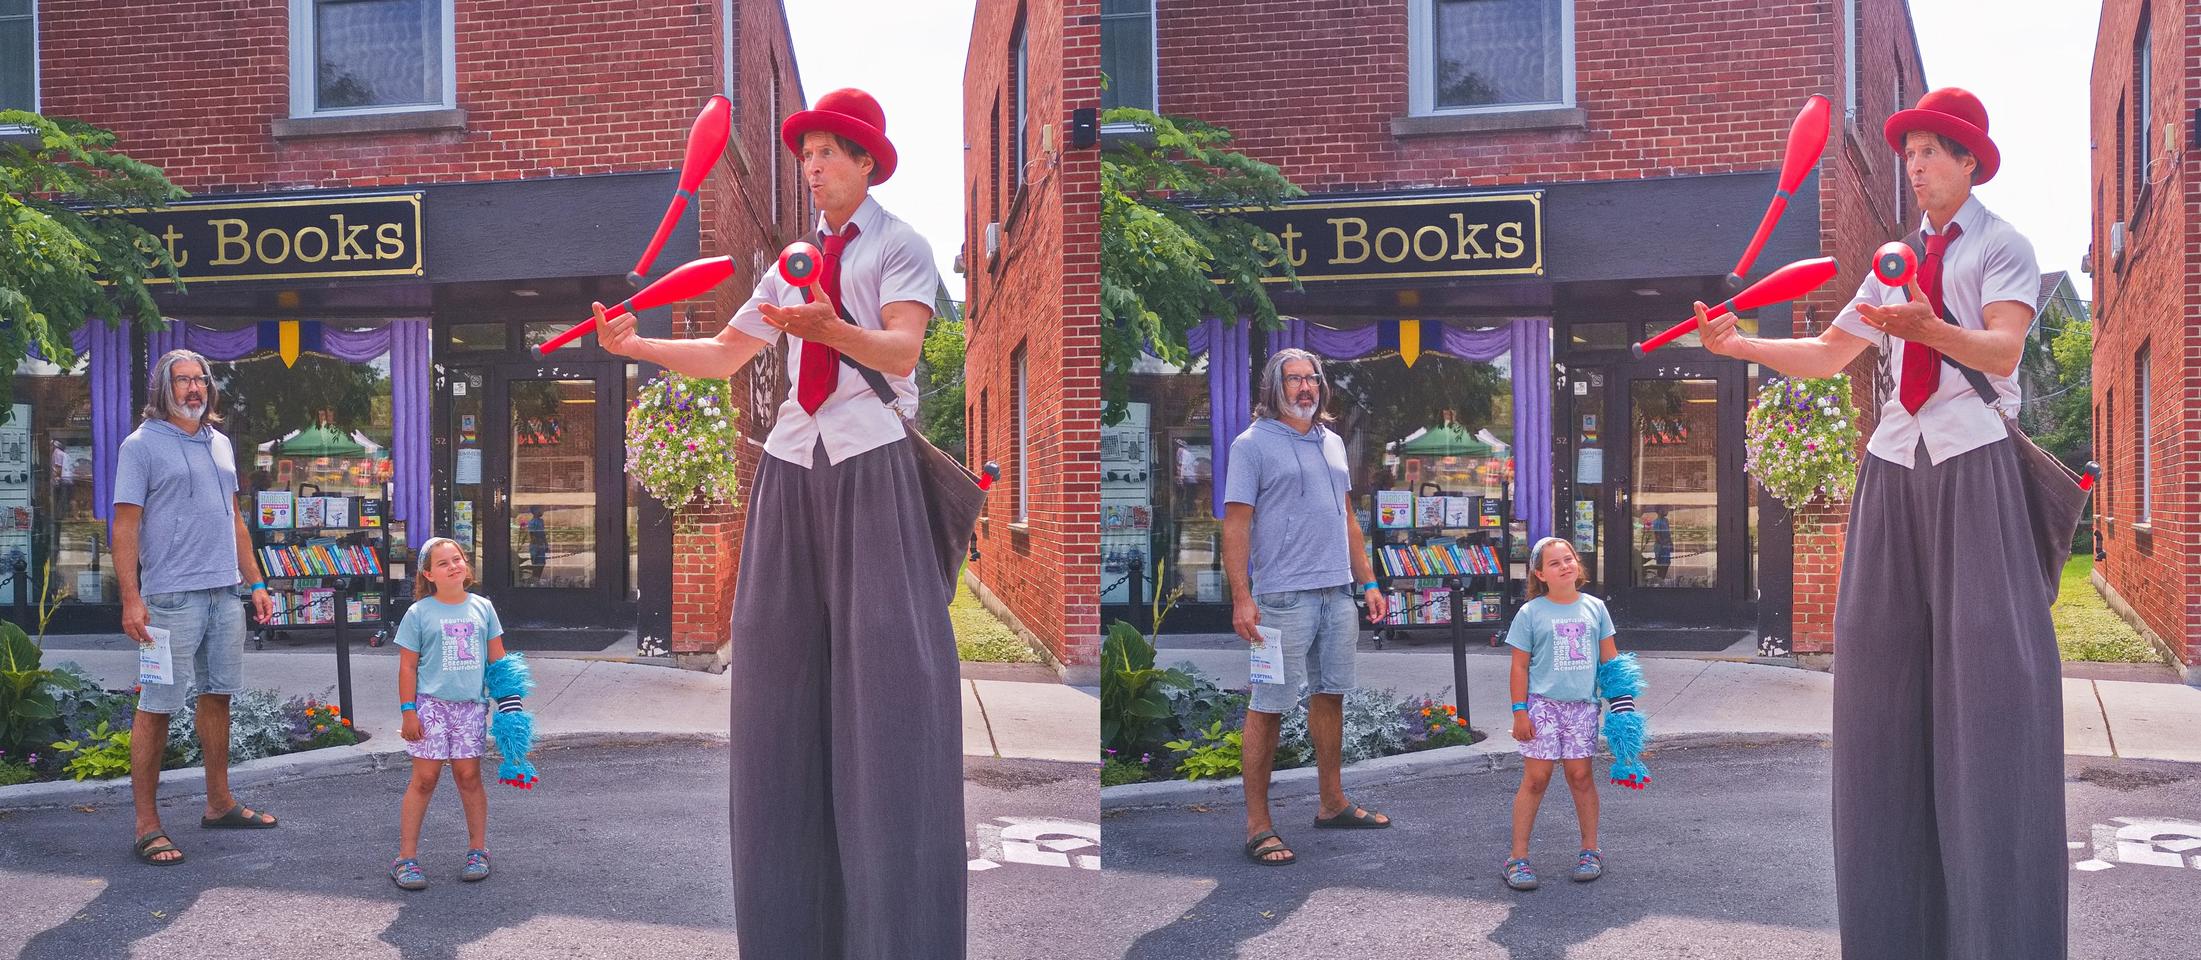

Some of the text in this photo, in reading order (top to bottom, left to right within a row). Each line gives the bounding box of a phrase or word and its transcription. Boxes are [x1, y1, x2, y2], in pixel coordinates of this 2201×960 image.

[207, 213, 405, 266] Books
[1326, 213, 1525, 265] Books
[435, 437, 446, 445] 52
[1556, 437, 1567, 445] 52
